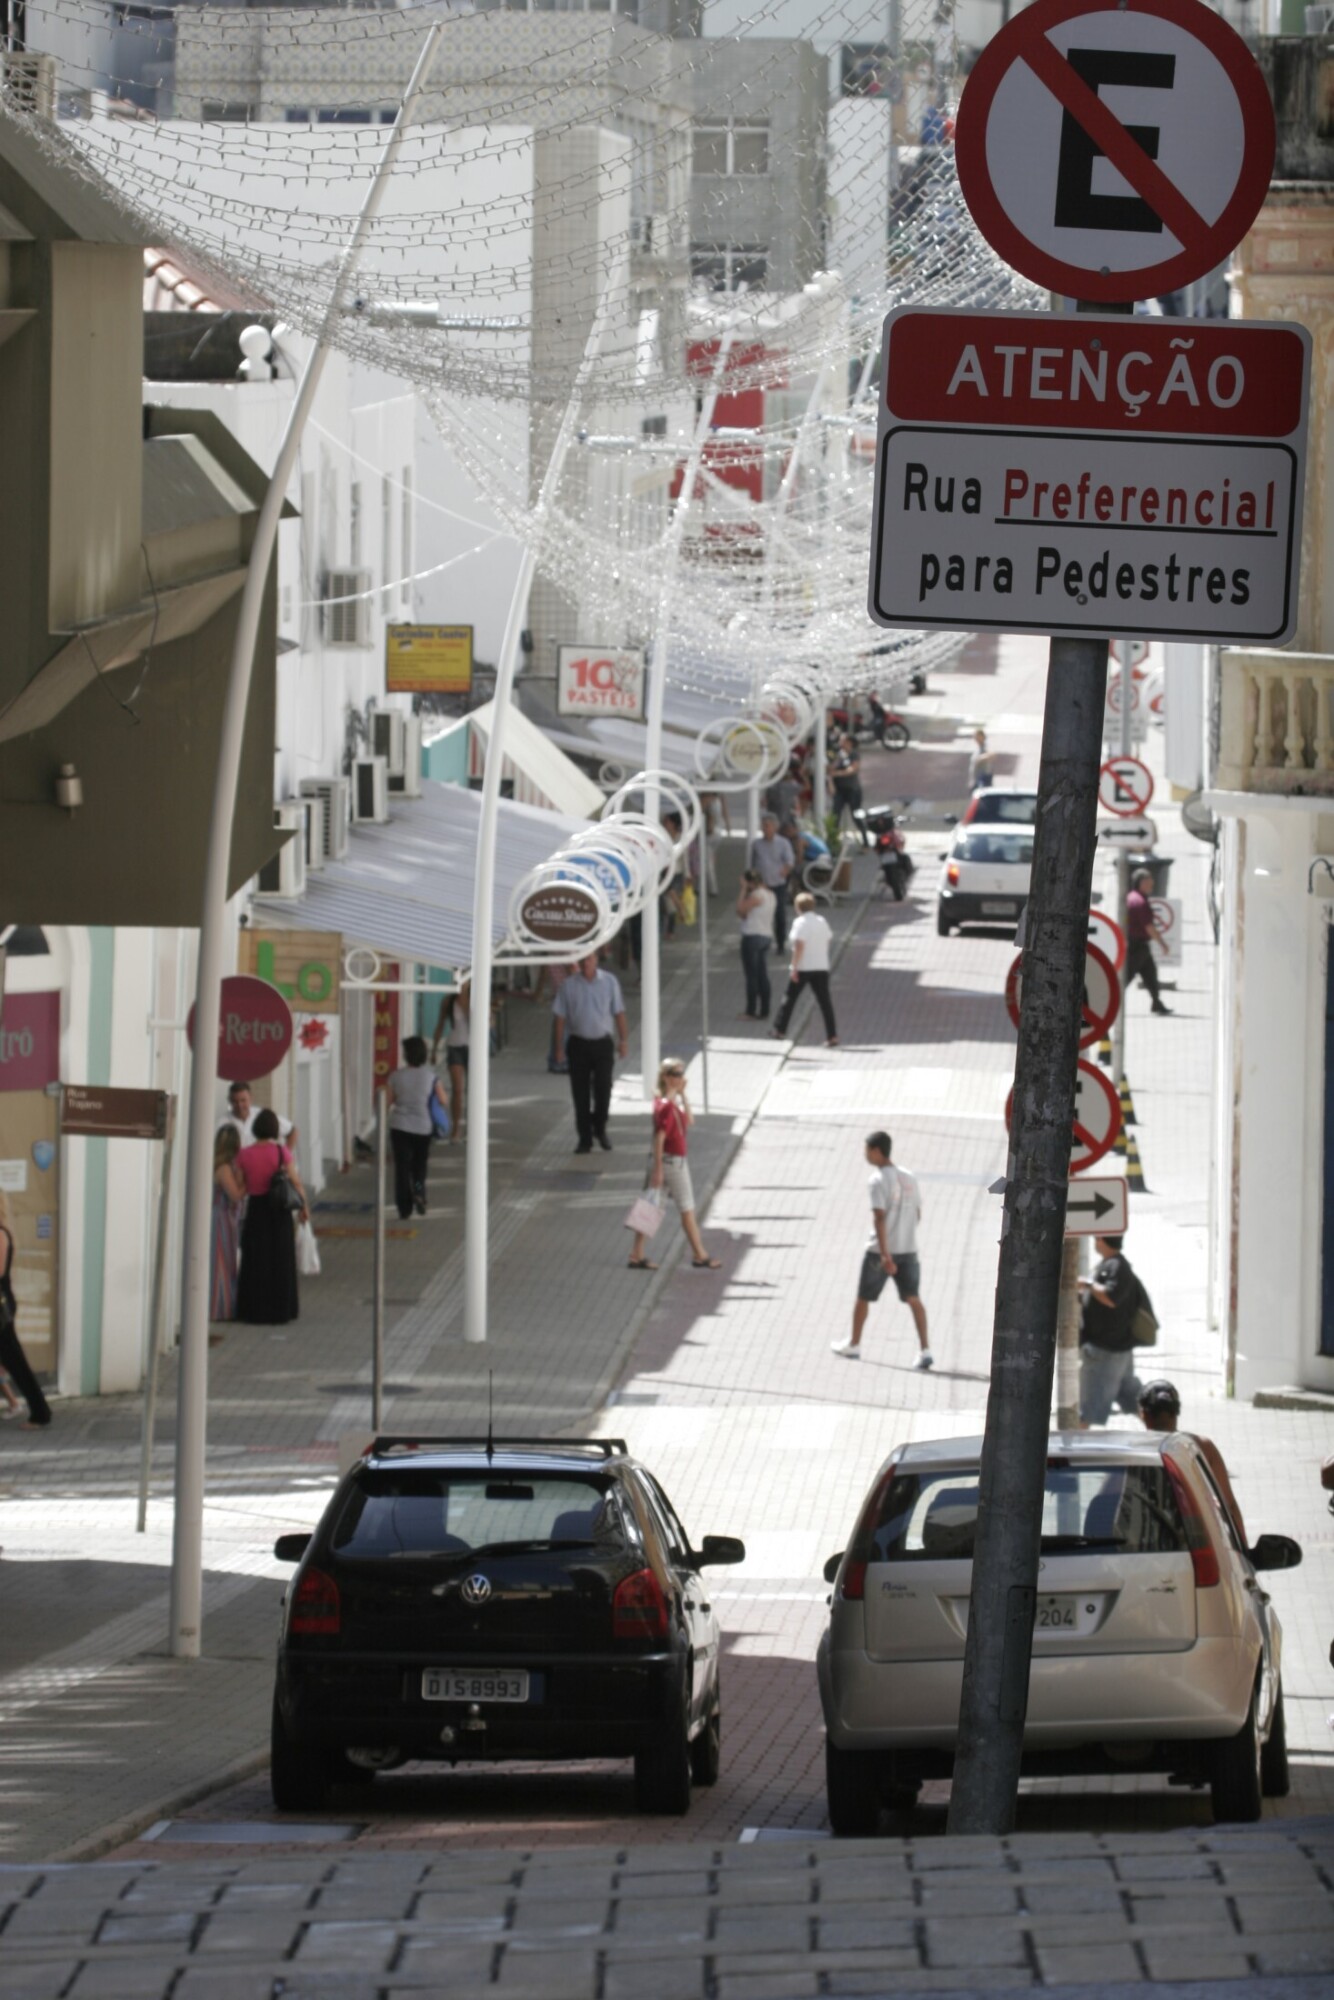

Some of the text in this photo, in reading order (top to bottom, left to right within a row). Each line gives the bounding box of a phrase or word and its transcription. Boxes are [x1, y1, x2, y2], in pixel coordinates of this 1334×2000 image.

[1054, 48, 1176, 234] E
[946, 338, 1246, 418] ATENÇÃO
[903, 462, 1275, 529] Rua Preferencial
[919, 546, 1251, 606] para Pedestres
